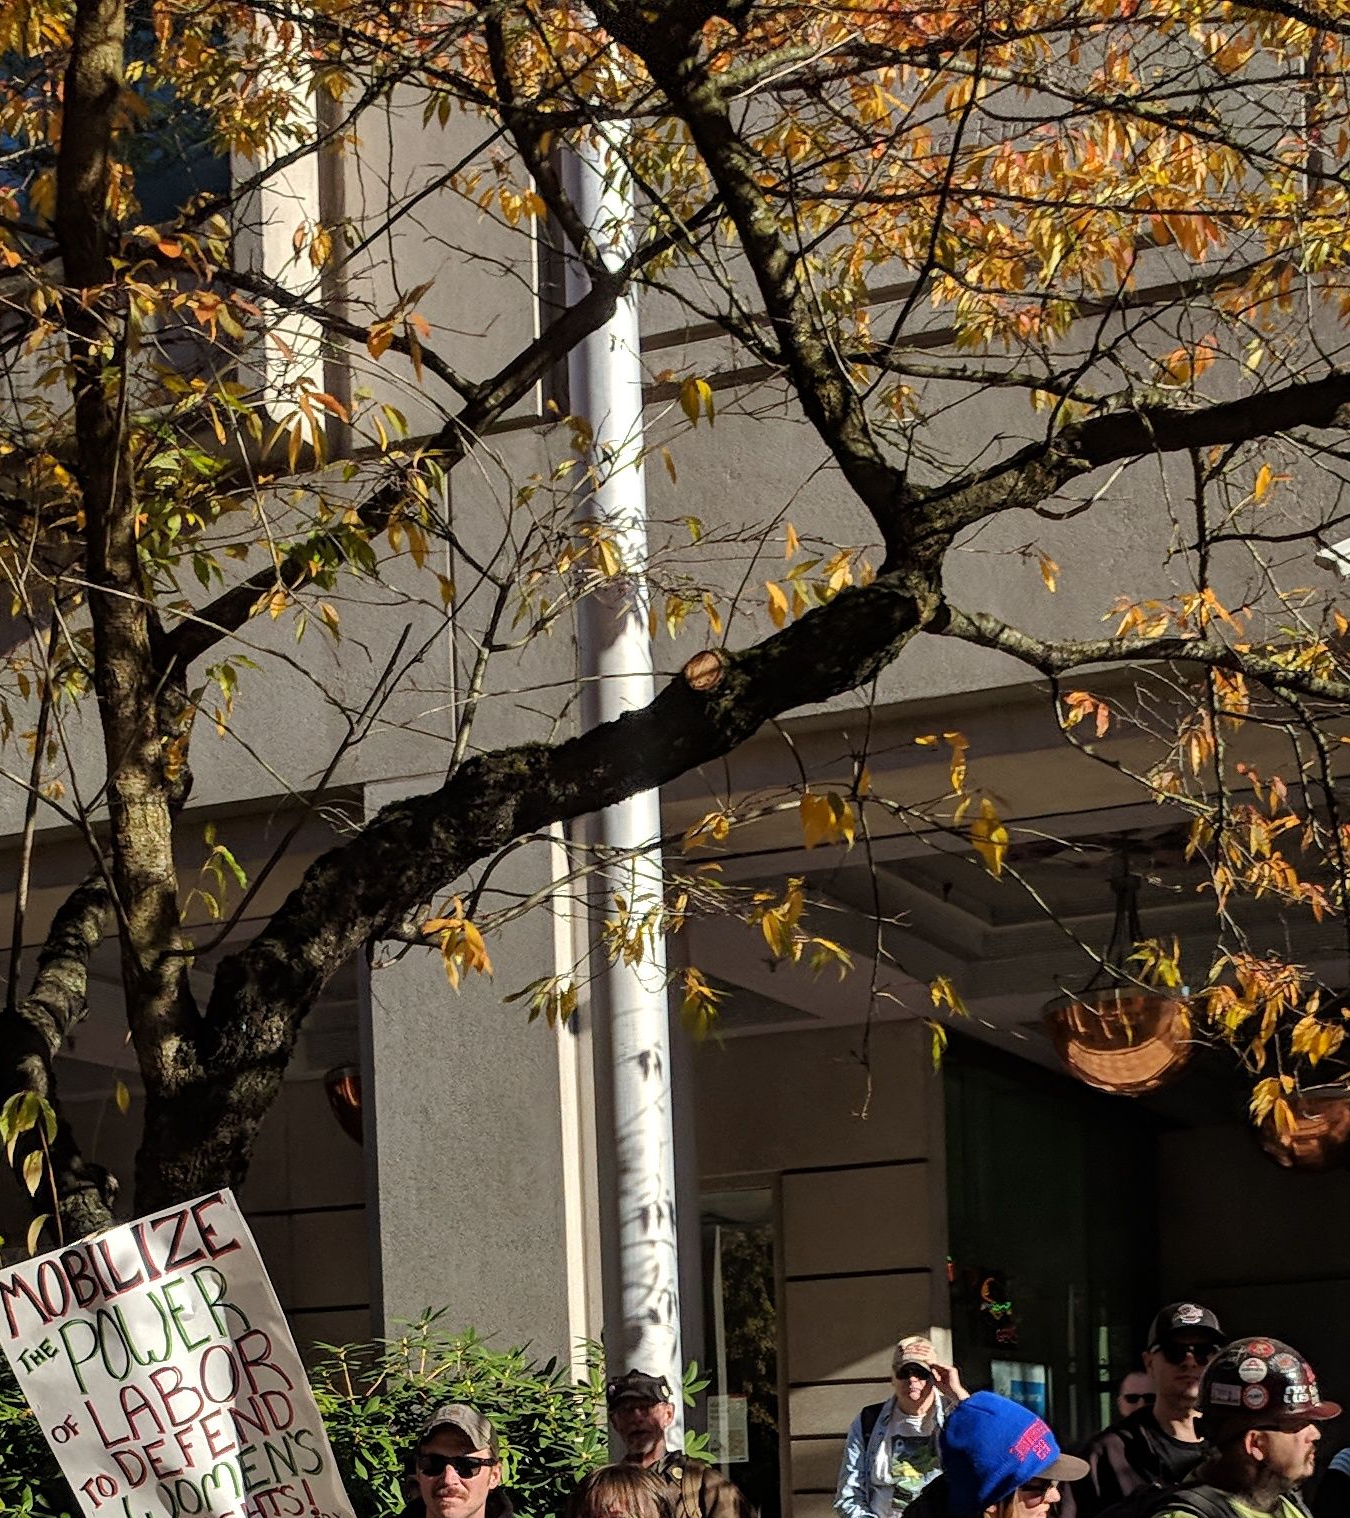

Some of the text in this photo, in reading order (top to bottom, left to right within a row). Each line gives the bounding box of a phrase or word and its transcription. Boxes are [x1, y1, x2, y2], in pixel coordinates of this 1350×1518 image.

[16, 1266, 252, 1395] THE POWER
[51, 1329, 294, 1450] OF LABOR
[80, 1389, 295, 1509] TO DEFEND
